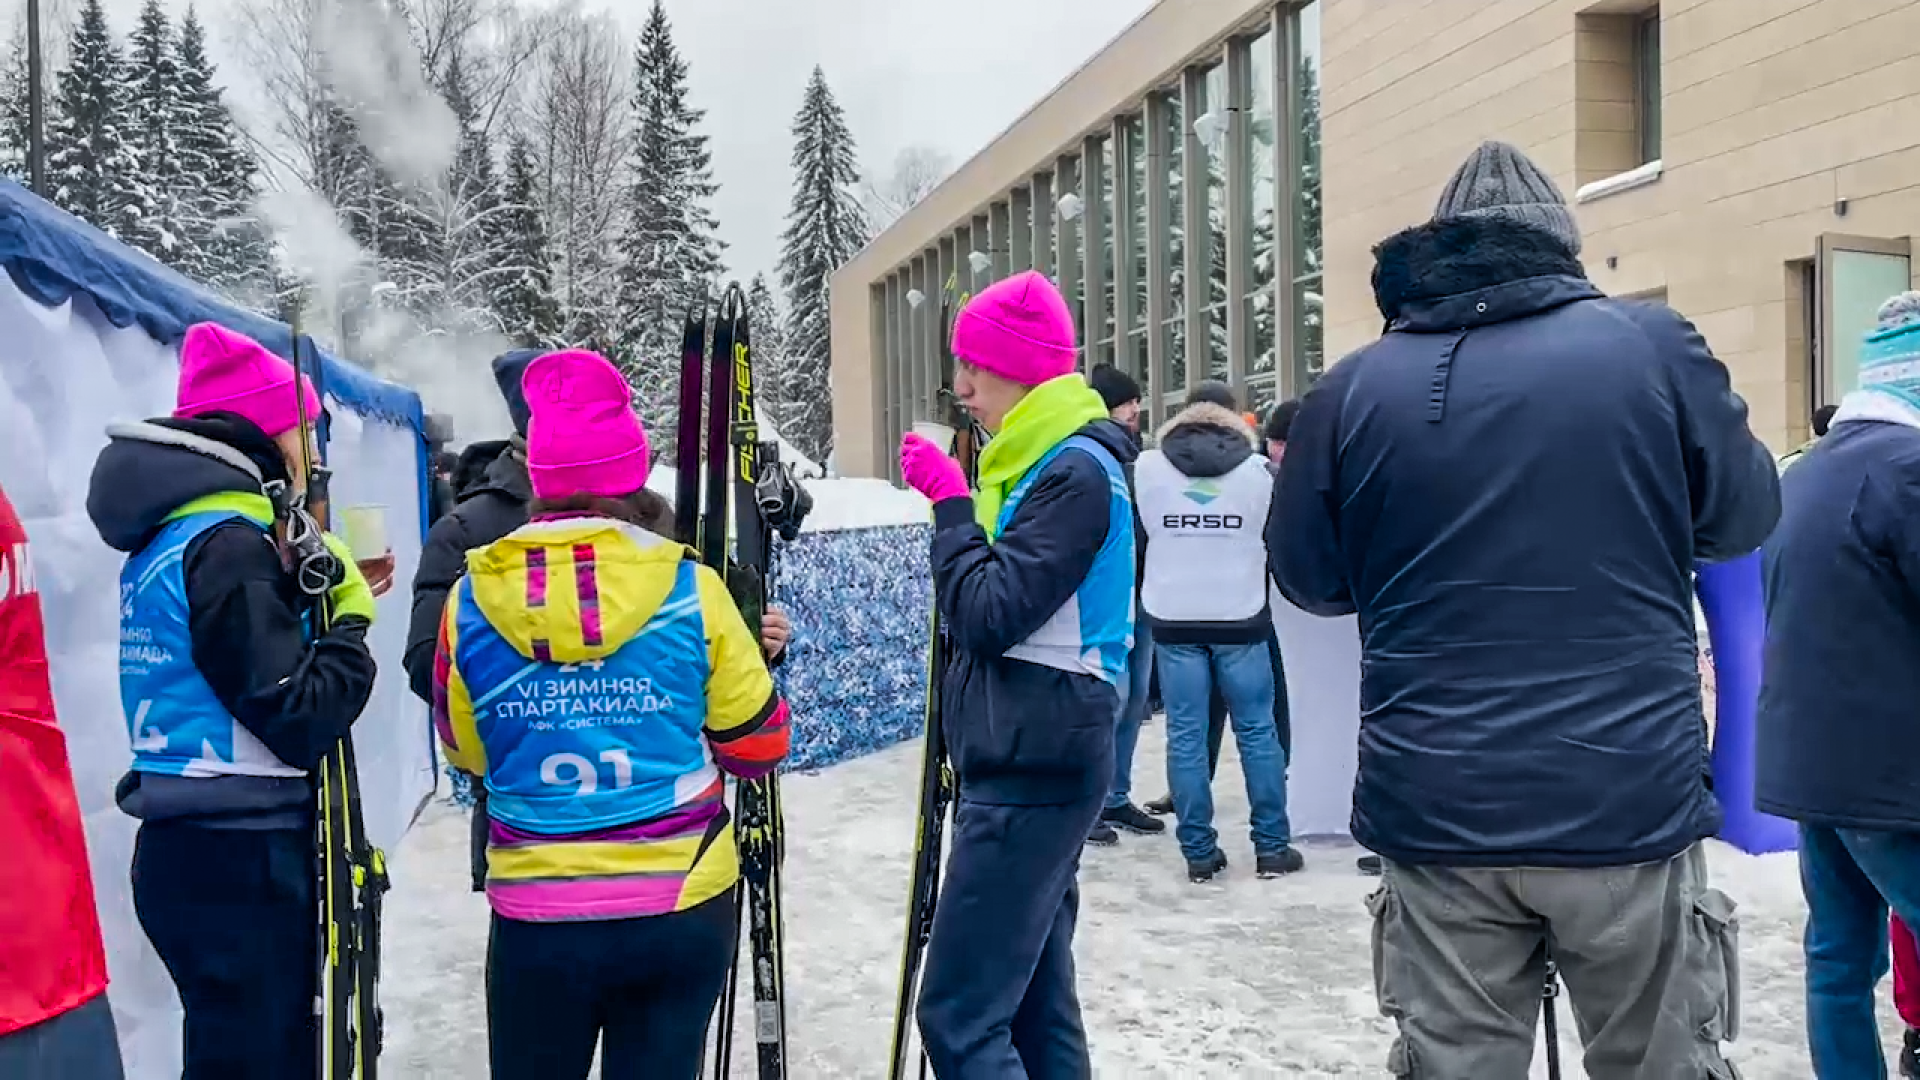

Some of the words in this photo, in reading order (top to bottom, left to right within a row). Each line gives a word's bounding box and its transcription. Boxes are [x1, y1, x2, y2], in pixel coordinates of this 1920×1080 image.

[734, 342, 756, 484] FICHER
[496, 694, 674, 718] СПАРТАКИАДА
[516, 680, 539, 699] VI
[544, 677, 652, 698] ЗИМНЯЯ
[540, 748, 632, 796] 91
